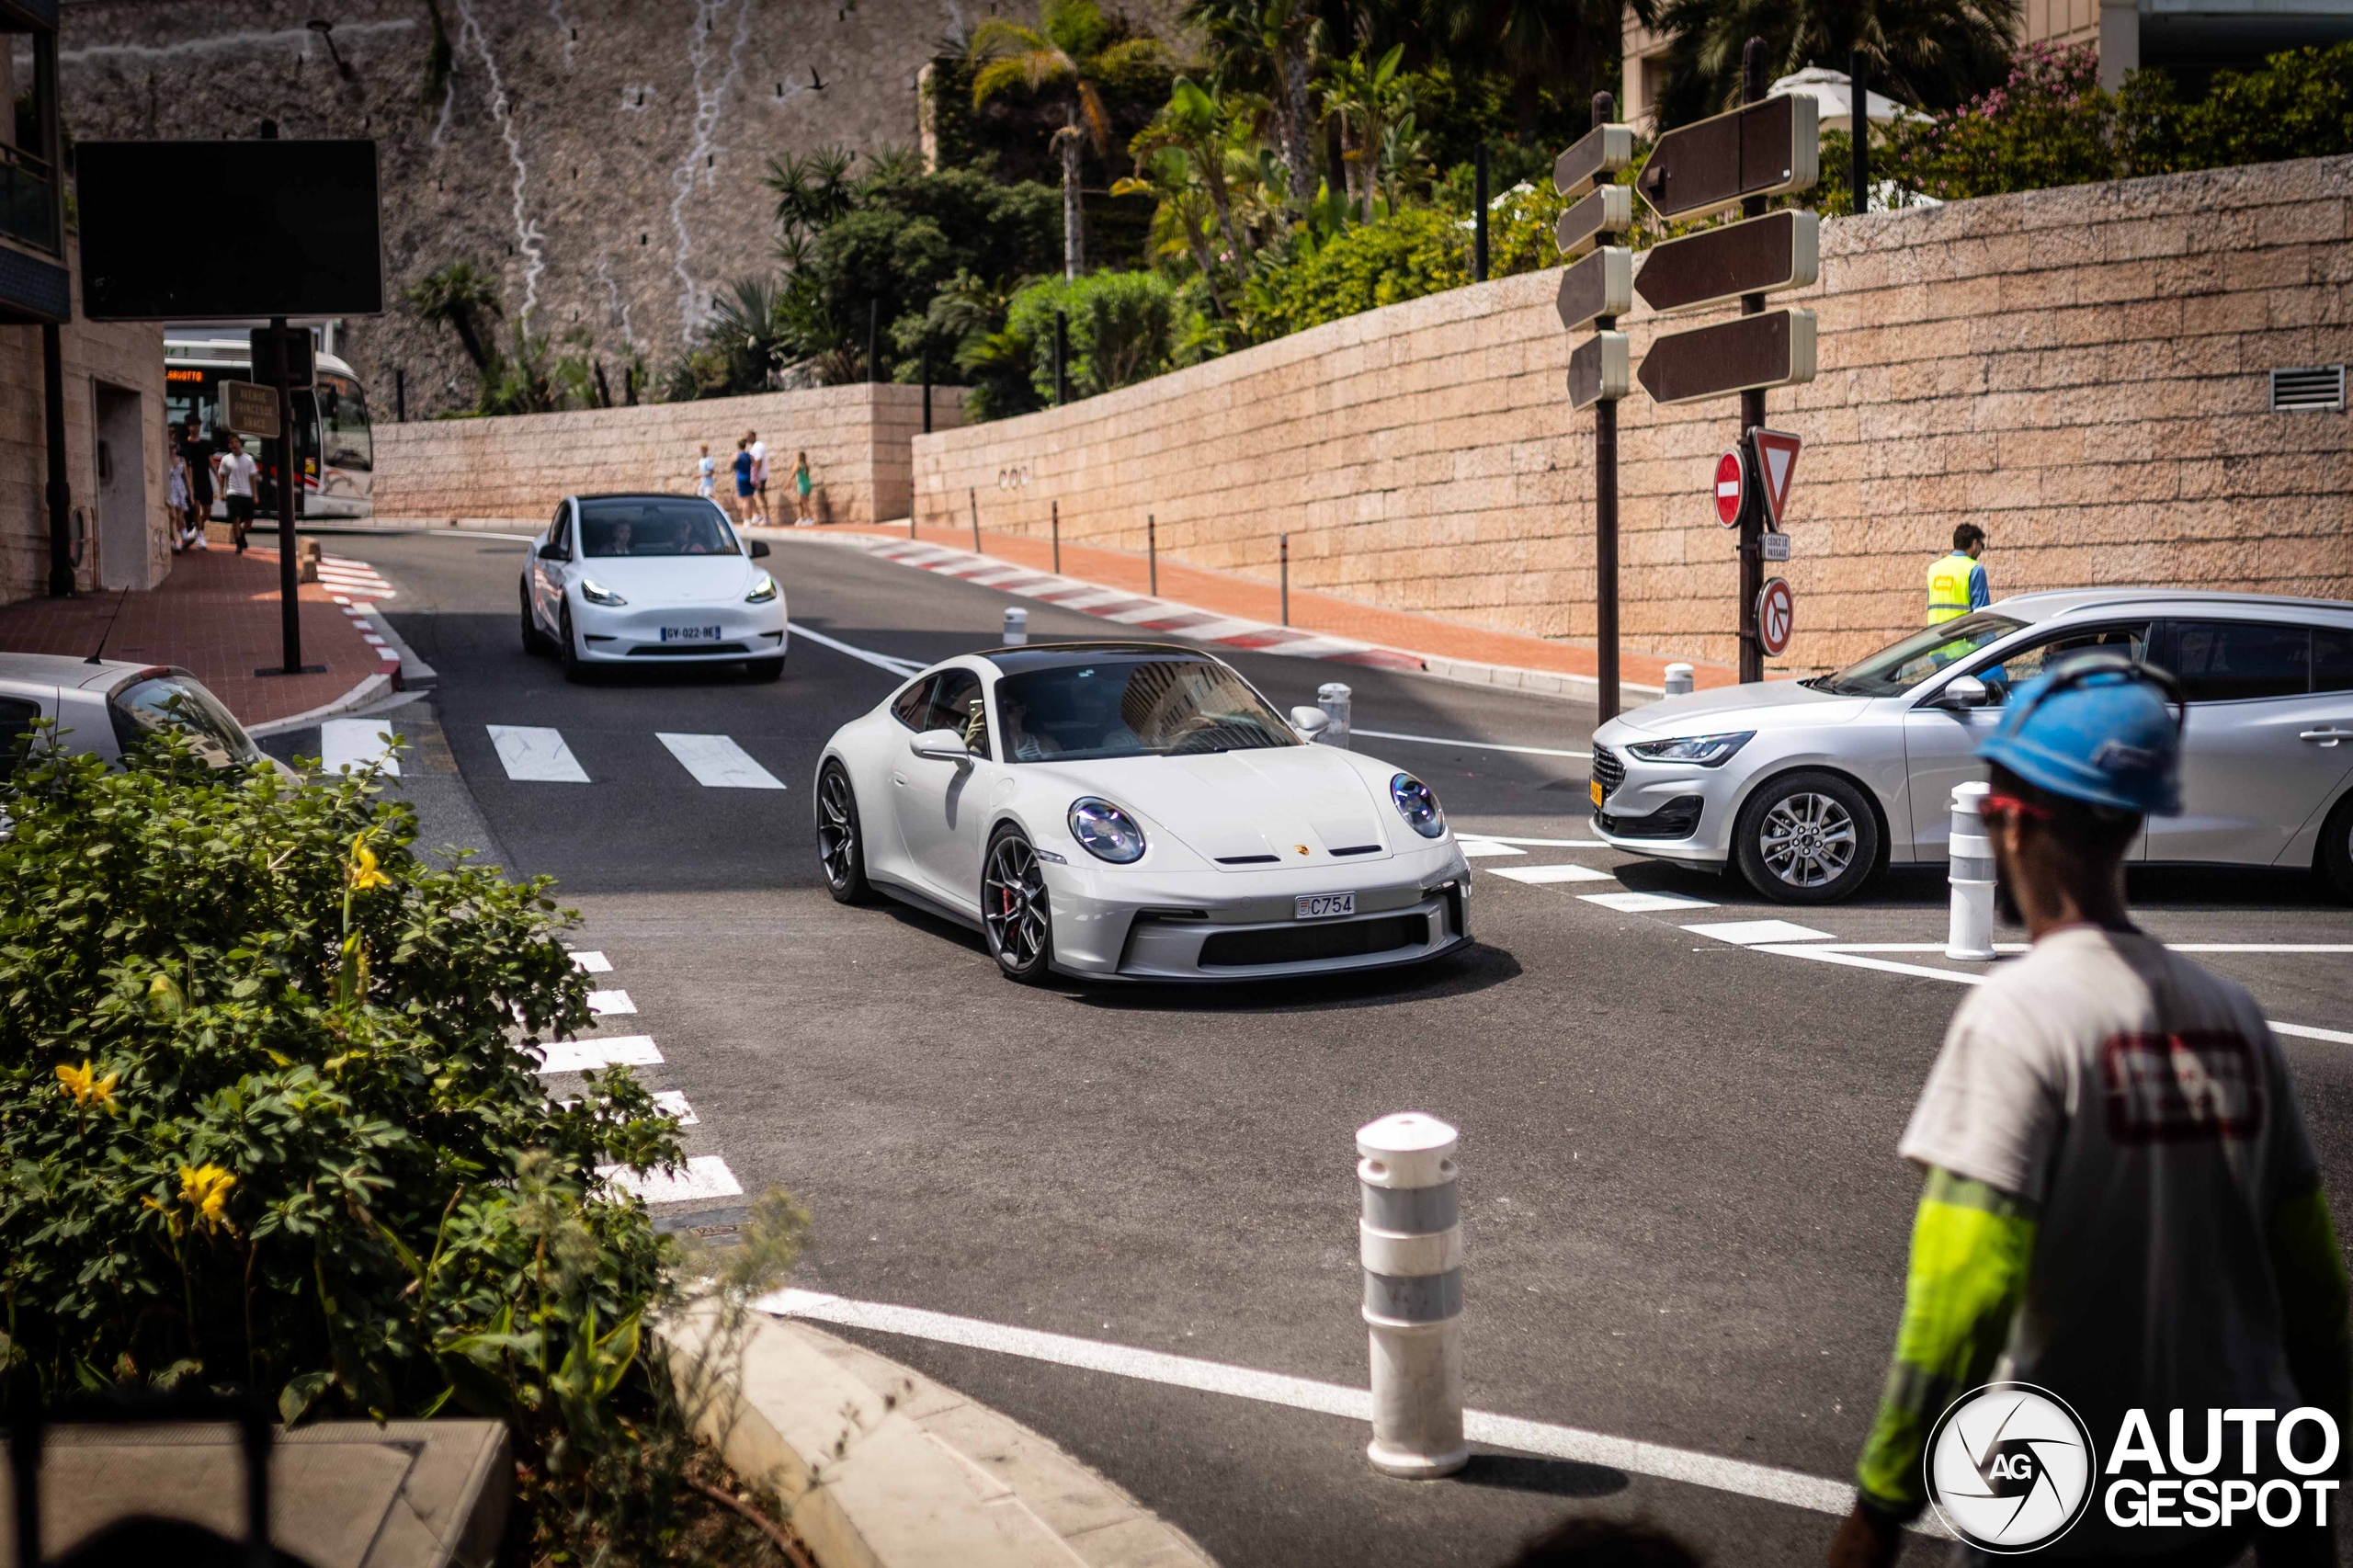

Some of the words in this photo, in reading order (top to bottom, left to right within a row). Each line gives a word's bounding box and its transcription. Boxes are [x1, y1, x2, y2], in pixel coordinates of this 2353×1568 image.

[1782, 538, 1788, 548] LE
[1768, 548, 1787, 558] PASSAGE
[1311, 896, 1352, 915] C754
